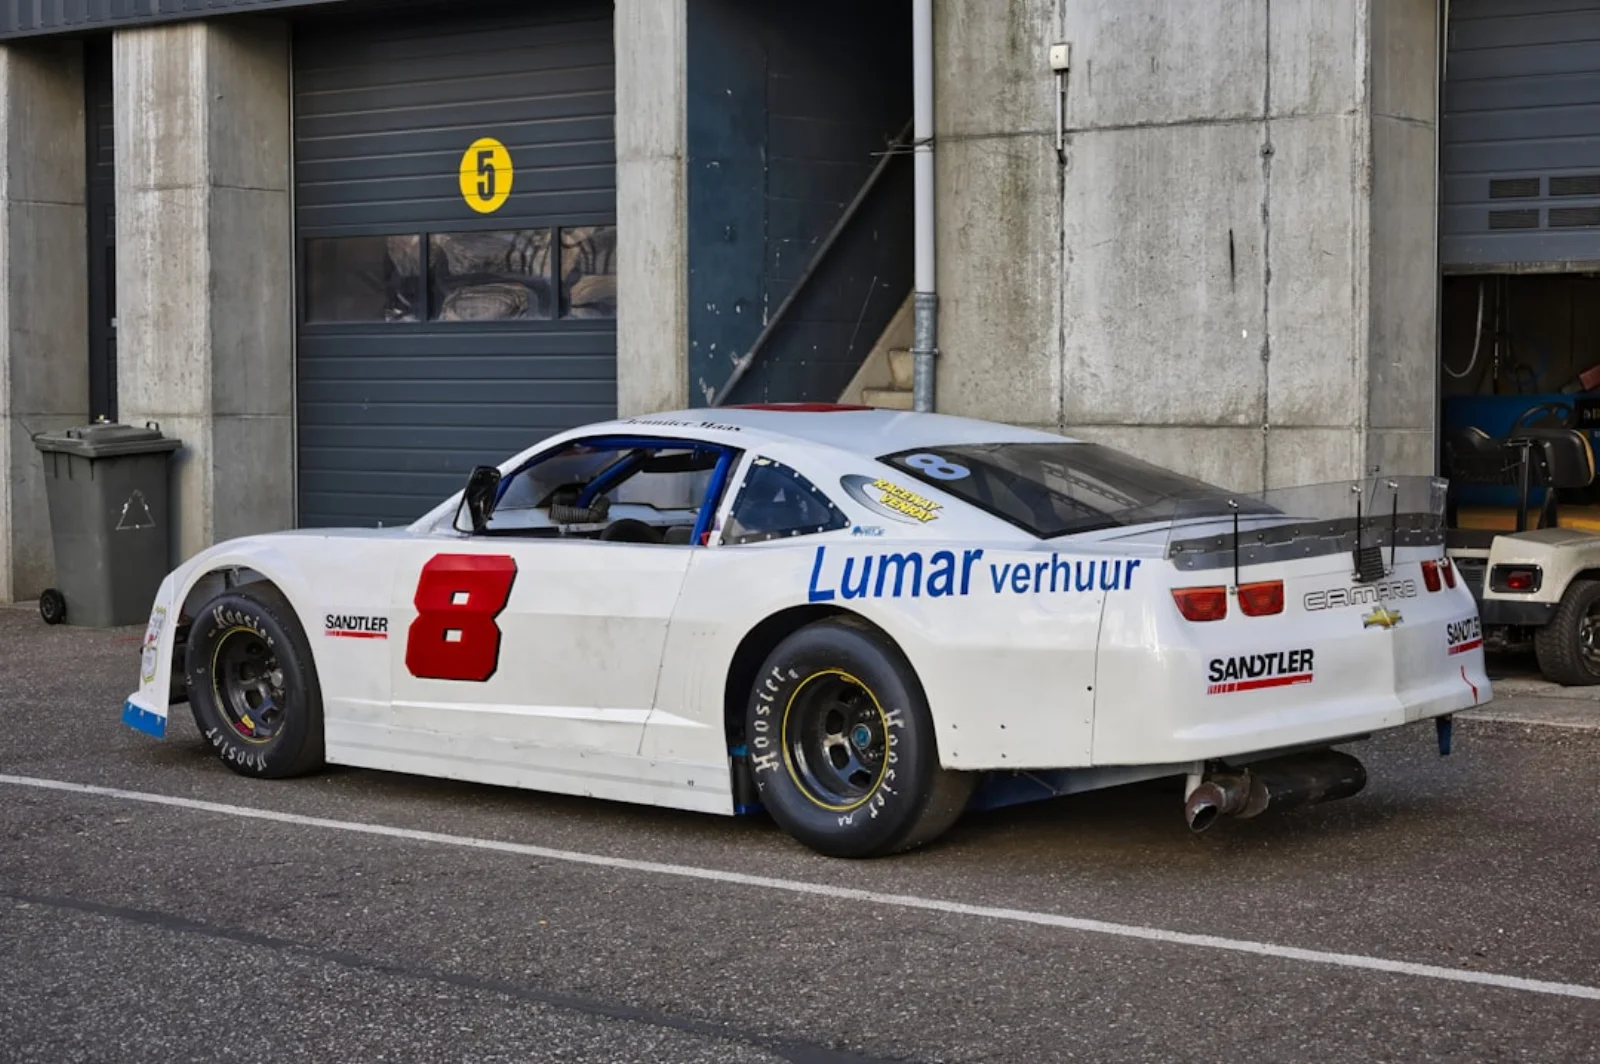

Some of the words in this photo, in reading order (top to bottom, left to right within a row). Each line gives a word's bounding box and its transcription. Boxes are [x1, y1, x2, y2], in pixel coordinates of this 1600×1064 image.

[477, 150, 495, 201] 5
[905, 453, 971, 481] 8
[872, 478, 943, 511] RACEWAY
[879, 494, 939, 523] VENRAY
[808, 545, 984, 602] Lumar
[990, 553, 1141, 593] verhuur
[1304, 580, 1417, 611] CAMARO
[213, 605, 274, 647] Hoosier
[325, 614, 388, 632] SANDTLER
[405, 553, 518, 682] 8
[1209, 649, 1314, 682] SANDTLER
[752, 666, 785, 772] Hoosier
[205, 726, 268, 772] Hoosier
[868, 708, 904, 819] Hoosier
